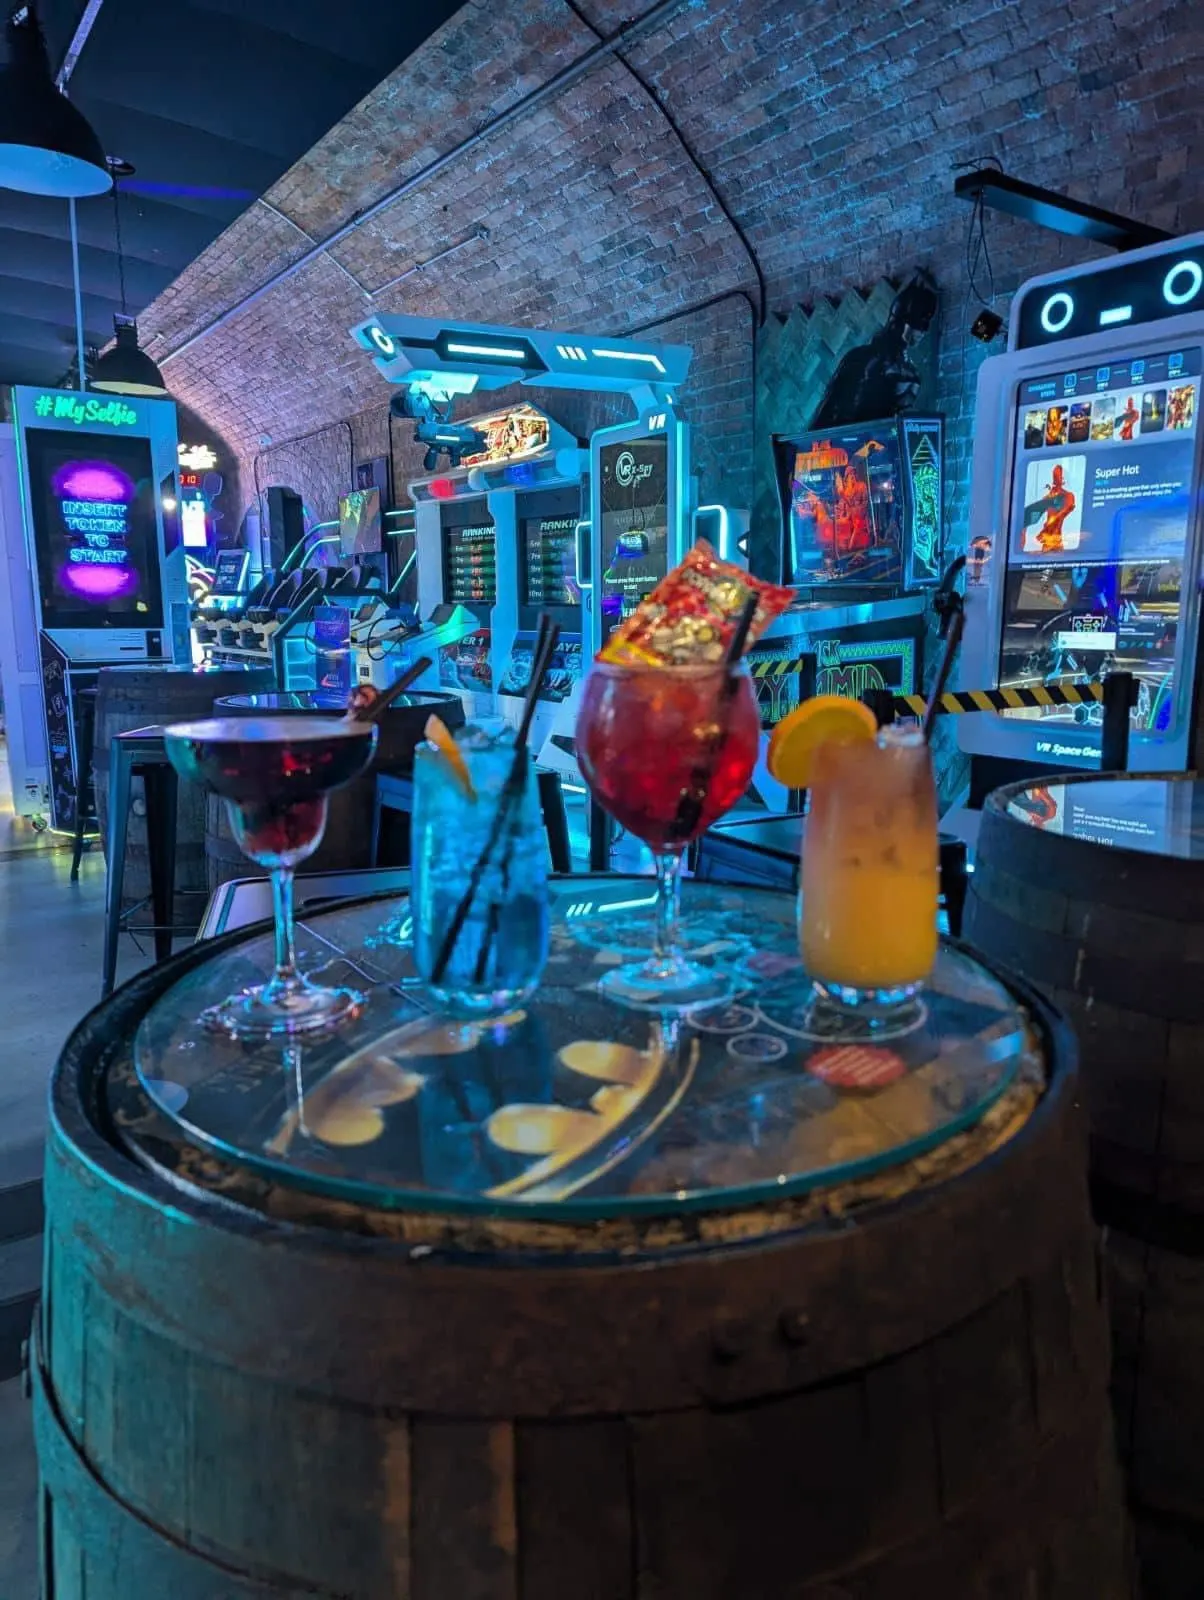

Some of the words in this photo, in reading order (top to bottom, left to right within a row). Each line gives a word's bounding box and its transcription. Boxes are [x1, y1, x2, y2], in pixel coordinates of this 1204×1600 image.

[649, 413, 666, 431] VR
[1095, 467, 1121, 479] Super
[1122, 464, 1140, 475] Hot
[63, 501, 127, 517] INSERT
[64, 517, 126, 533] TOKEN
[540, 520, 578, 531] RANKIN
[84, 534, 109, 547] TO
[70, 549, 127, 563] START
